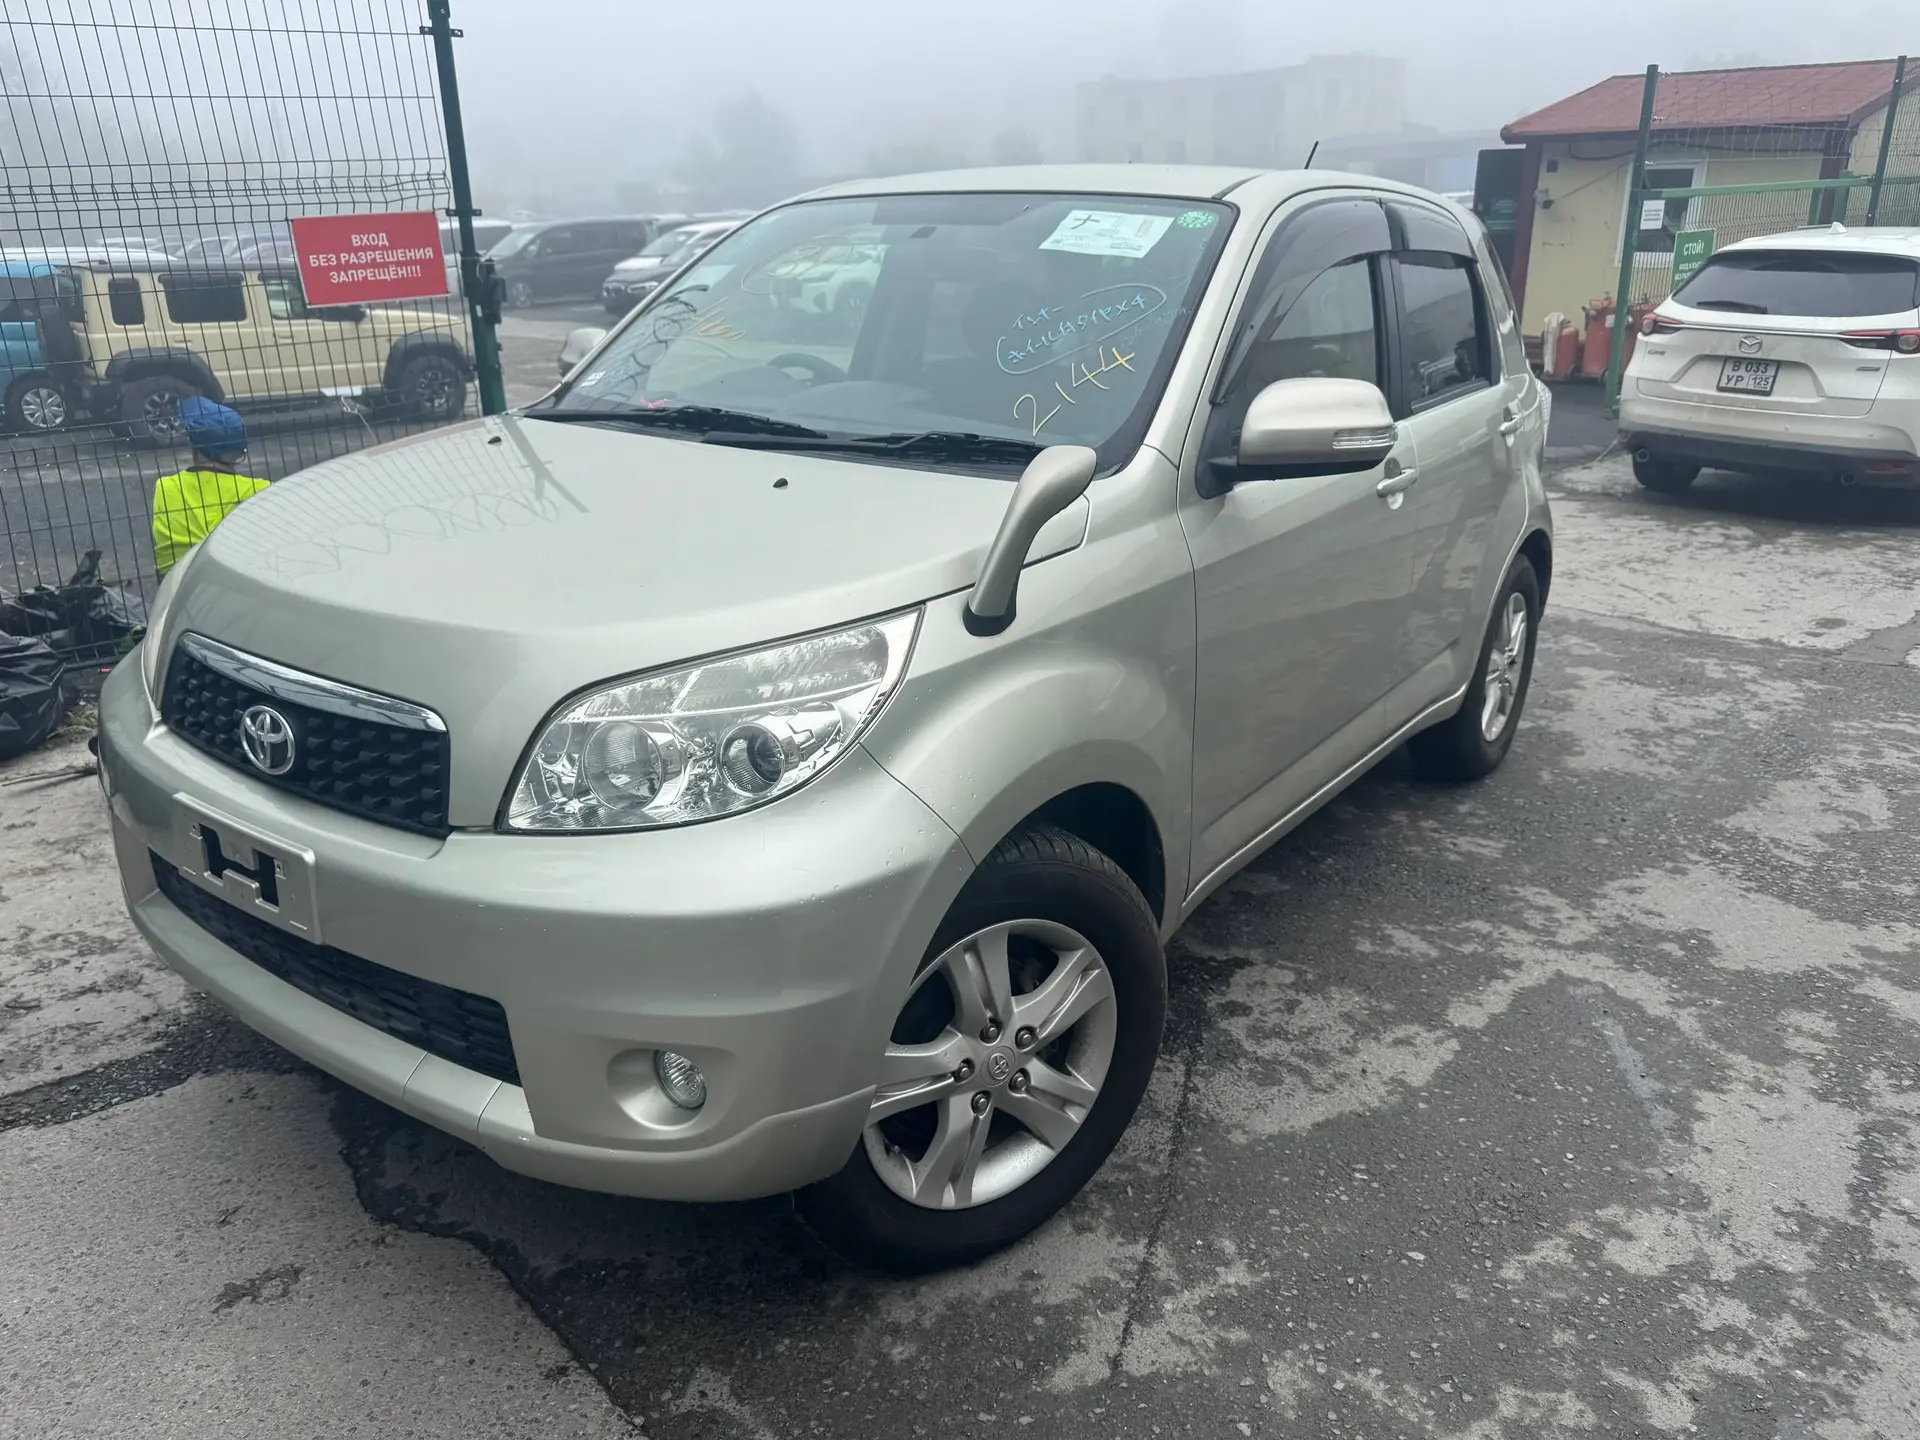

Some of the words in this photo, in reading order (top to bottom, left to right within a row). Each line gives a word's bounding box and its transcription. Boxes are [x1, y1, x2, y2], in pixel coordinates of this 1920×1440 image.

[351, 233, 389, 247] ВХОД
[1683, 239, 1704, 256] СТОЙ!
[308, 253, 337, 267] БЕЗ
[340, 247, 434, 265] РАЗРЕШЕНИЯ
[329, 265, 422, 284] ЗАПРЕЩЁН!!!
[1744, 361, 1769, 374] 033
[1725, 374, 1745, 386] УР
[1751, 376, 1770, 386] 125
[1013, 345, 1136, 437] 2144
